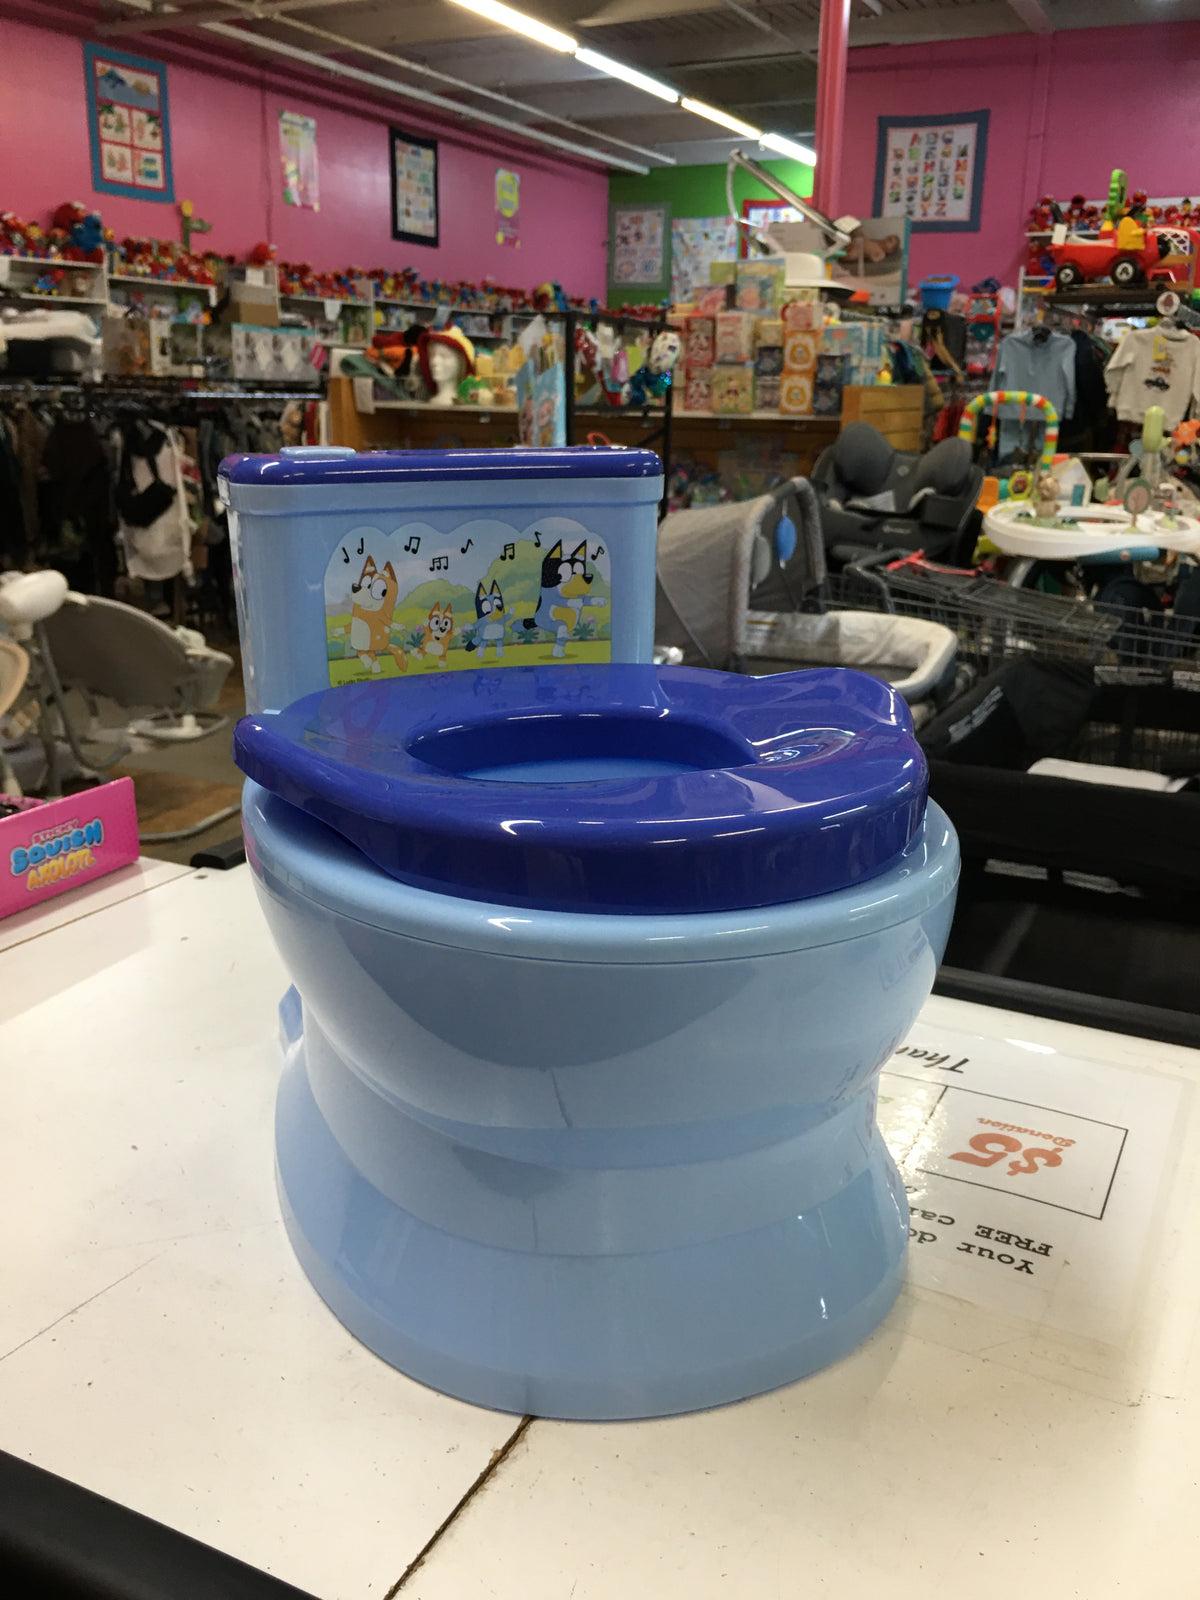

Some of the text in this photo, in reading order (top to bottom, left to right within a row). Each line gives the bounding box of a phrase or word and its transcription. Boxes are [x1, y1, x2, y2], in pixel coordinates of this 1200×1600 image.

[11, 819, 103, 875] SQUISH
[27, 848, 97, 891] AXOLOTL
[976, 1117, 1077, 1148] Donation
[948, 1132, 1064, 1176] $5
[956, 1241, 1034, 1275] Your
[975, 1224, 1053, 1257] FREE
